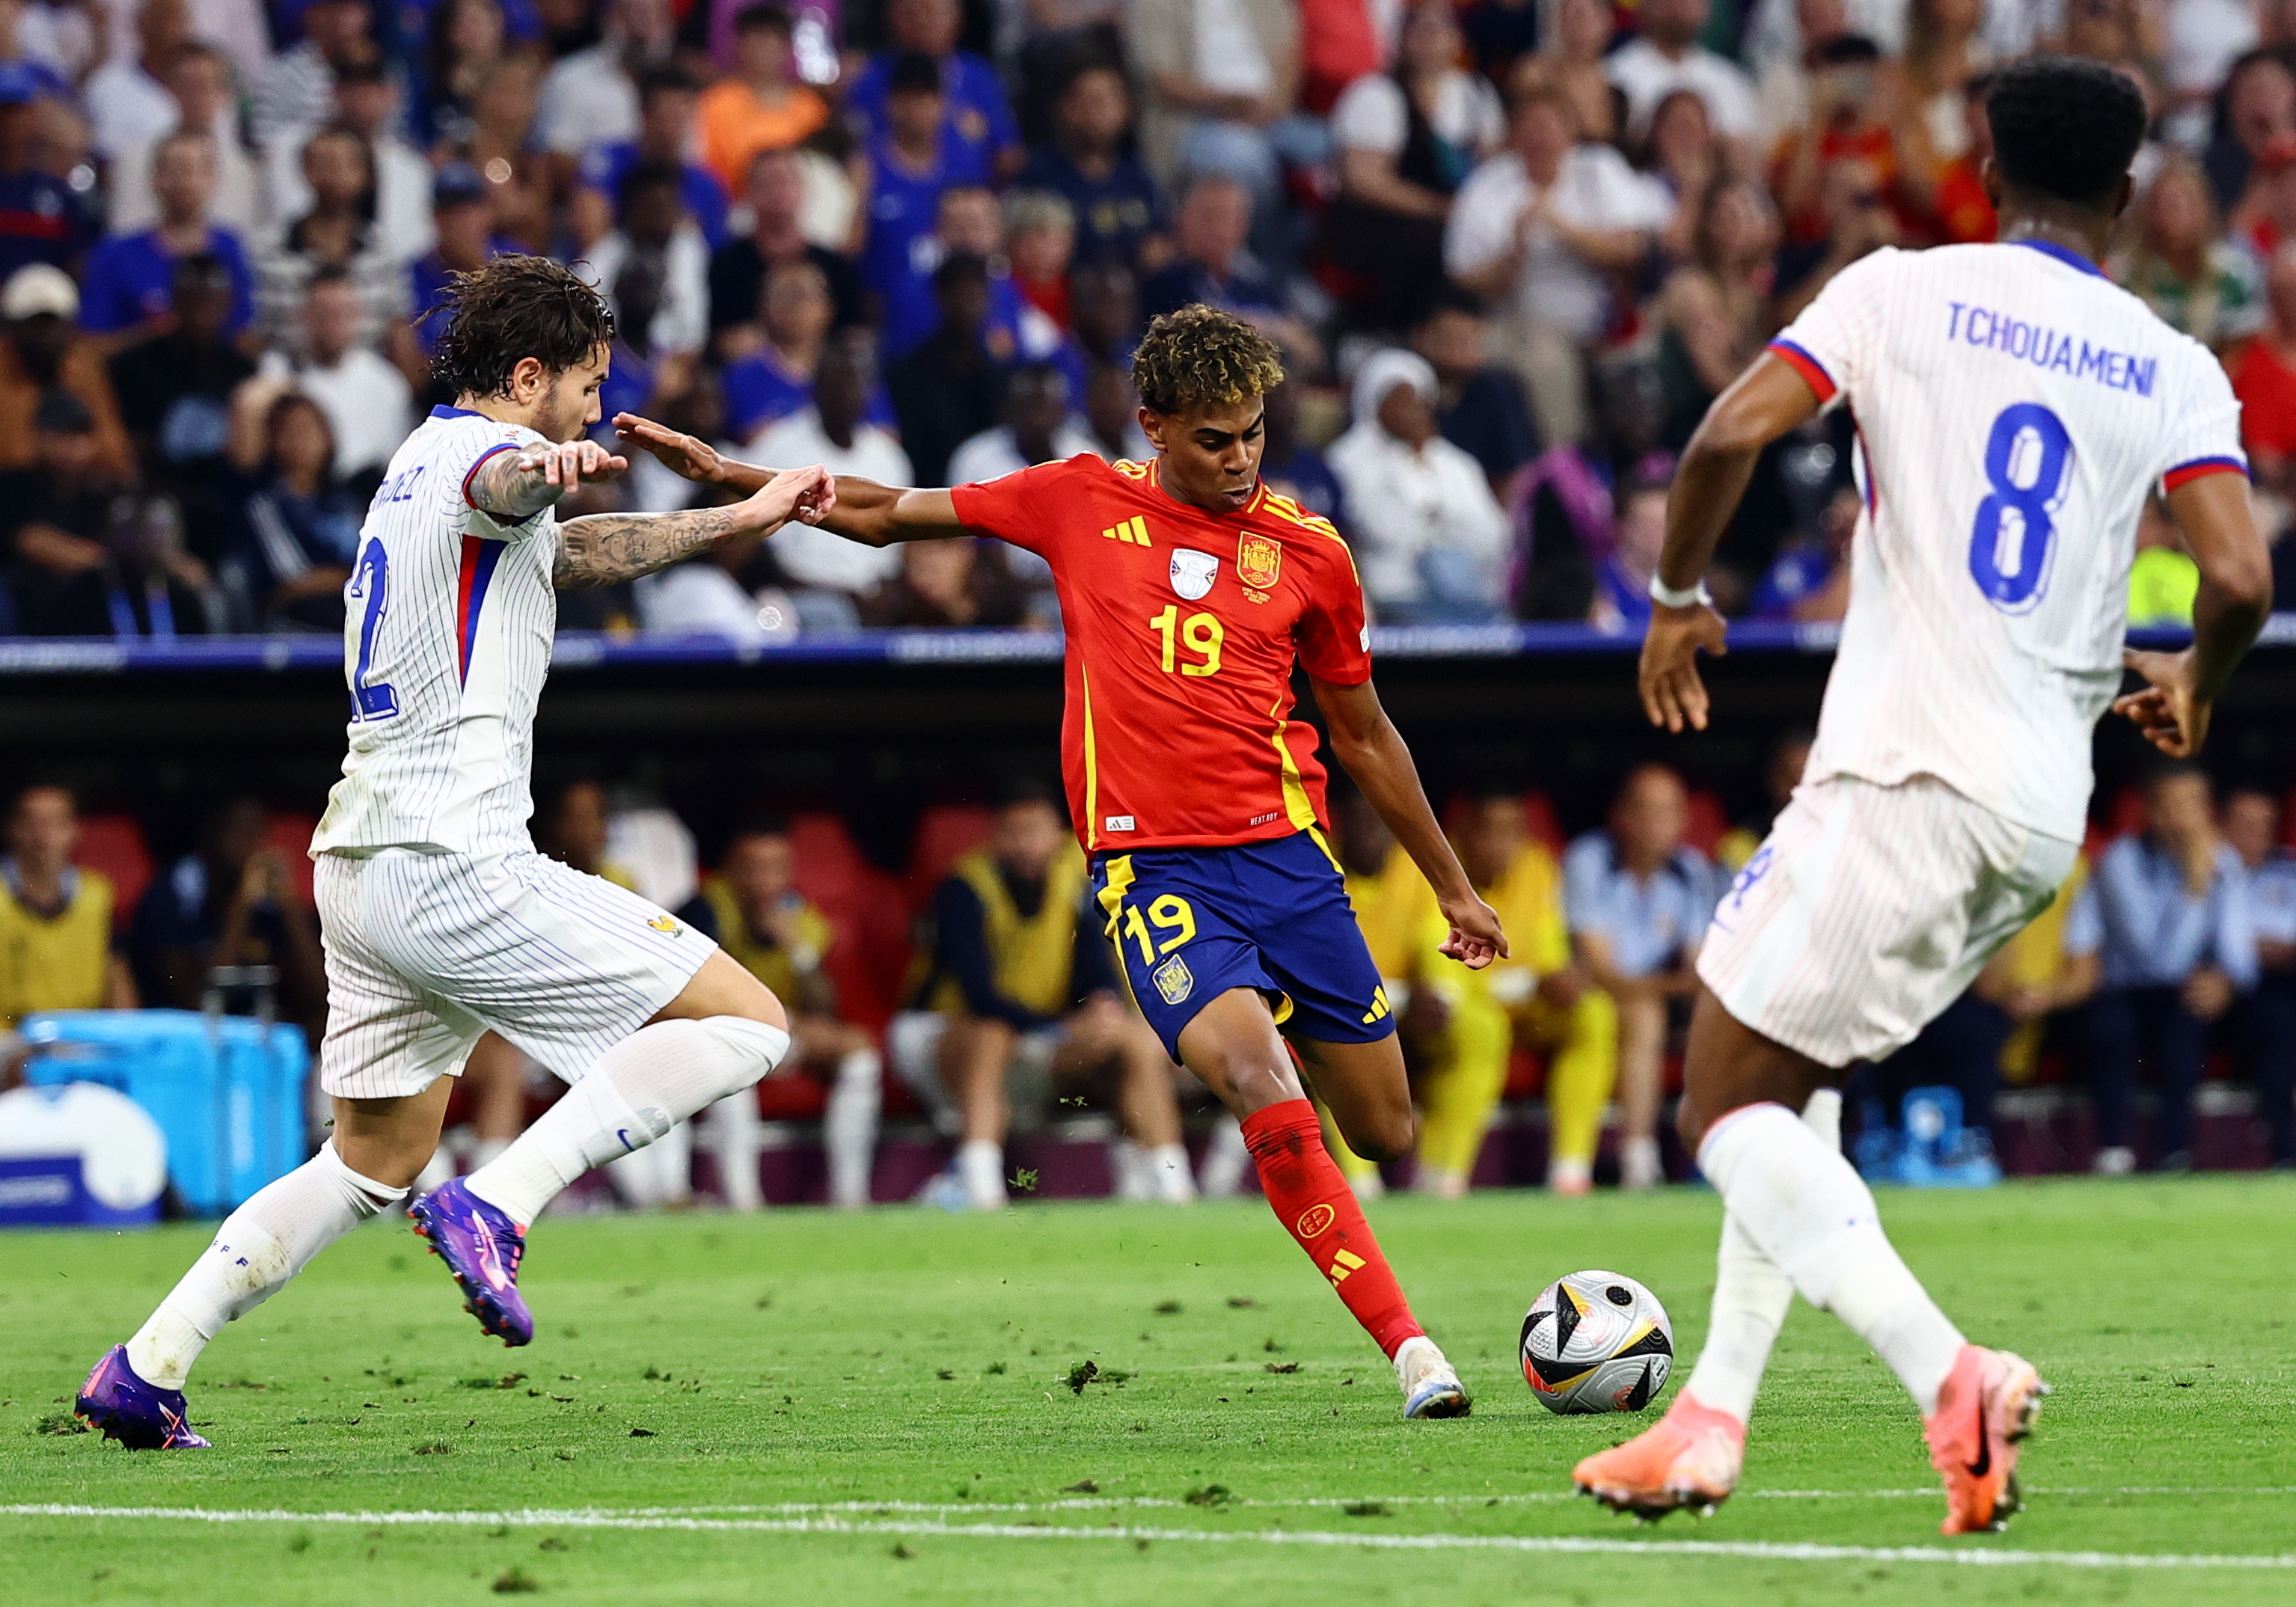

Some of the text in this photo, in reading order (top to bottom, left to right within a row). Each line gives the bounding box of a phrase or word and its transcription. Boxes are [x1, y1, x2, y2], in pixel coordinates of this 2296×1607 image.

[1948, 301, 2157, 397] TCHOUAMENI
[1968, 402, 2076, 616] 8
[1150, 604, 1224, 677] 19
[1124, 894, 1197, 967] 19
